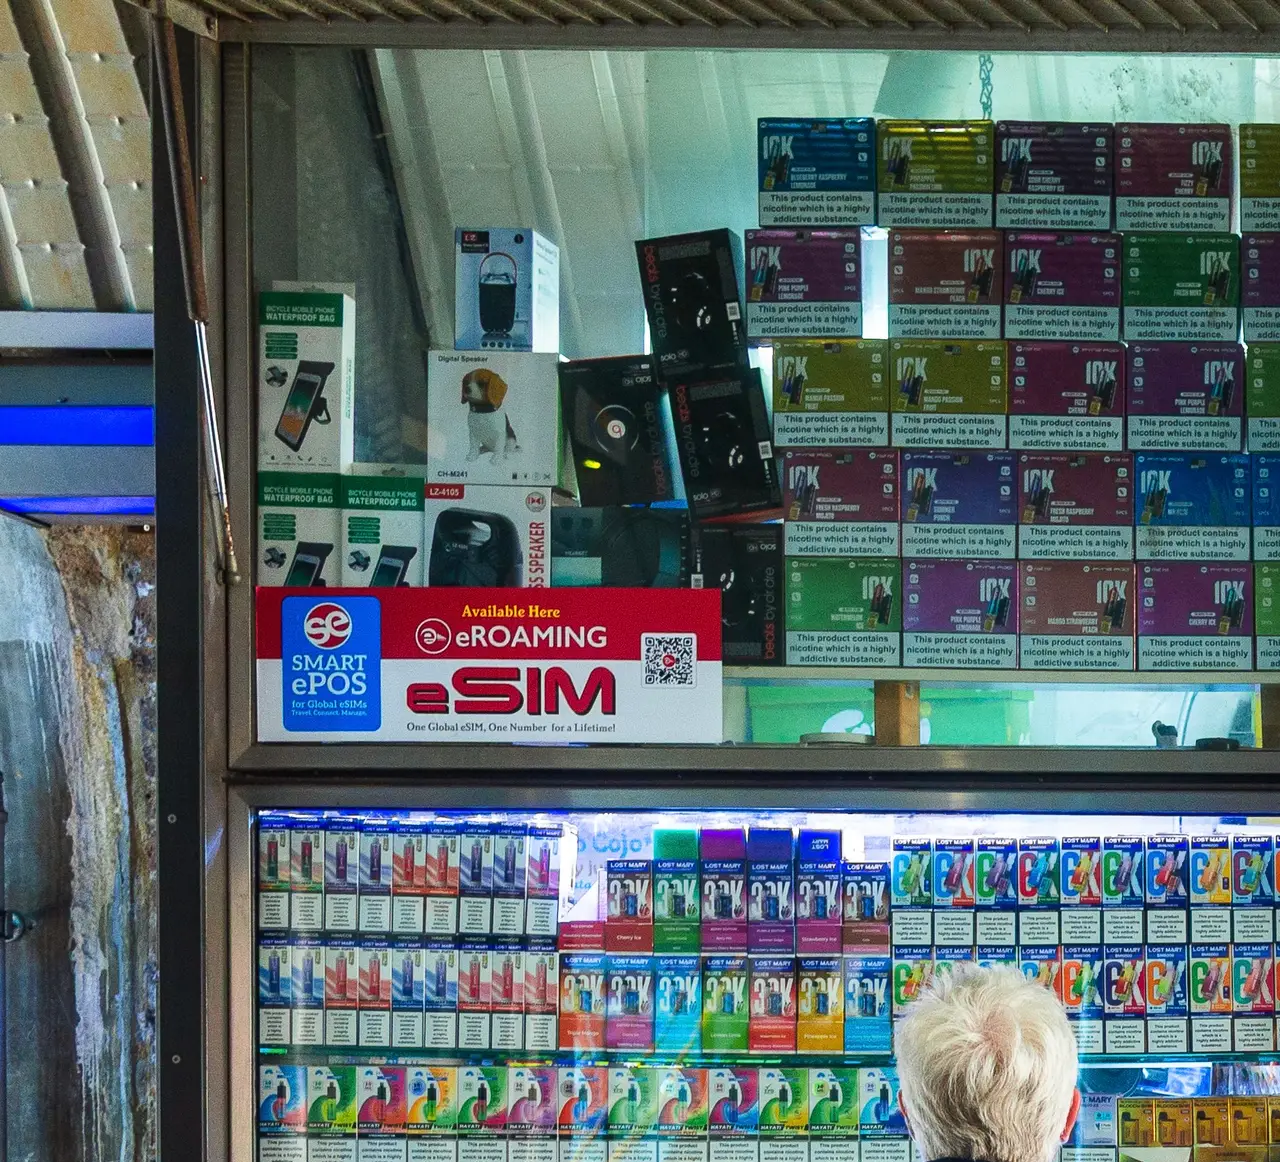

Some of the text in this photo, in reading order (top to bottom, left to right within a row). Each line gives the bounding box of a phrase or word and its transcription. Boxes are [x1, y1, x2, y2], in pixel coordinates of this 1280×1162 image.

[266, 313, 335, 322] WATERPROOF BAG
[430, 488, 459, 496] LZ-4105
[462, 606, 560, 619] Available Here
[456, 625, 607, 648] eROAMING
[1171, 639, 1202, 648] product
[1205, 639, 1240, 647] contains
[1142, 649, 1177, 657] nicotine
[1179, 649, 1203, 657] which
[1206, 649, 1212, 657] is
[1222, 649, 1248, 659] highly
[292, 655, 367, 671] SMART
[292, 672, 367, 695] ePOS
[406, 666, 616, 716] eSIM
[292, 700, 367, 708] for Global eSIMs
[407, 723, 426, 732] One
[429, 723, 458, 732] Global
[460, 723, 486, 733] eSIM,
[489, 723, 507, 732] One
[510, 723, 547, 732] Number
[551, 723, 564, 732] for
[575, 723, 615, 732] Lifetime!
